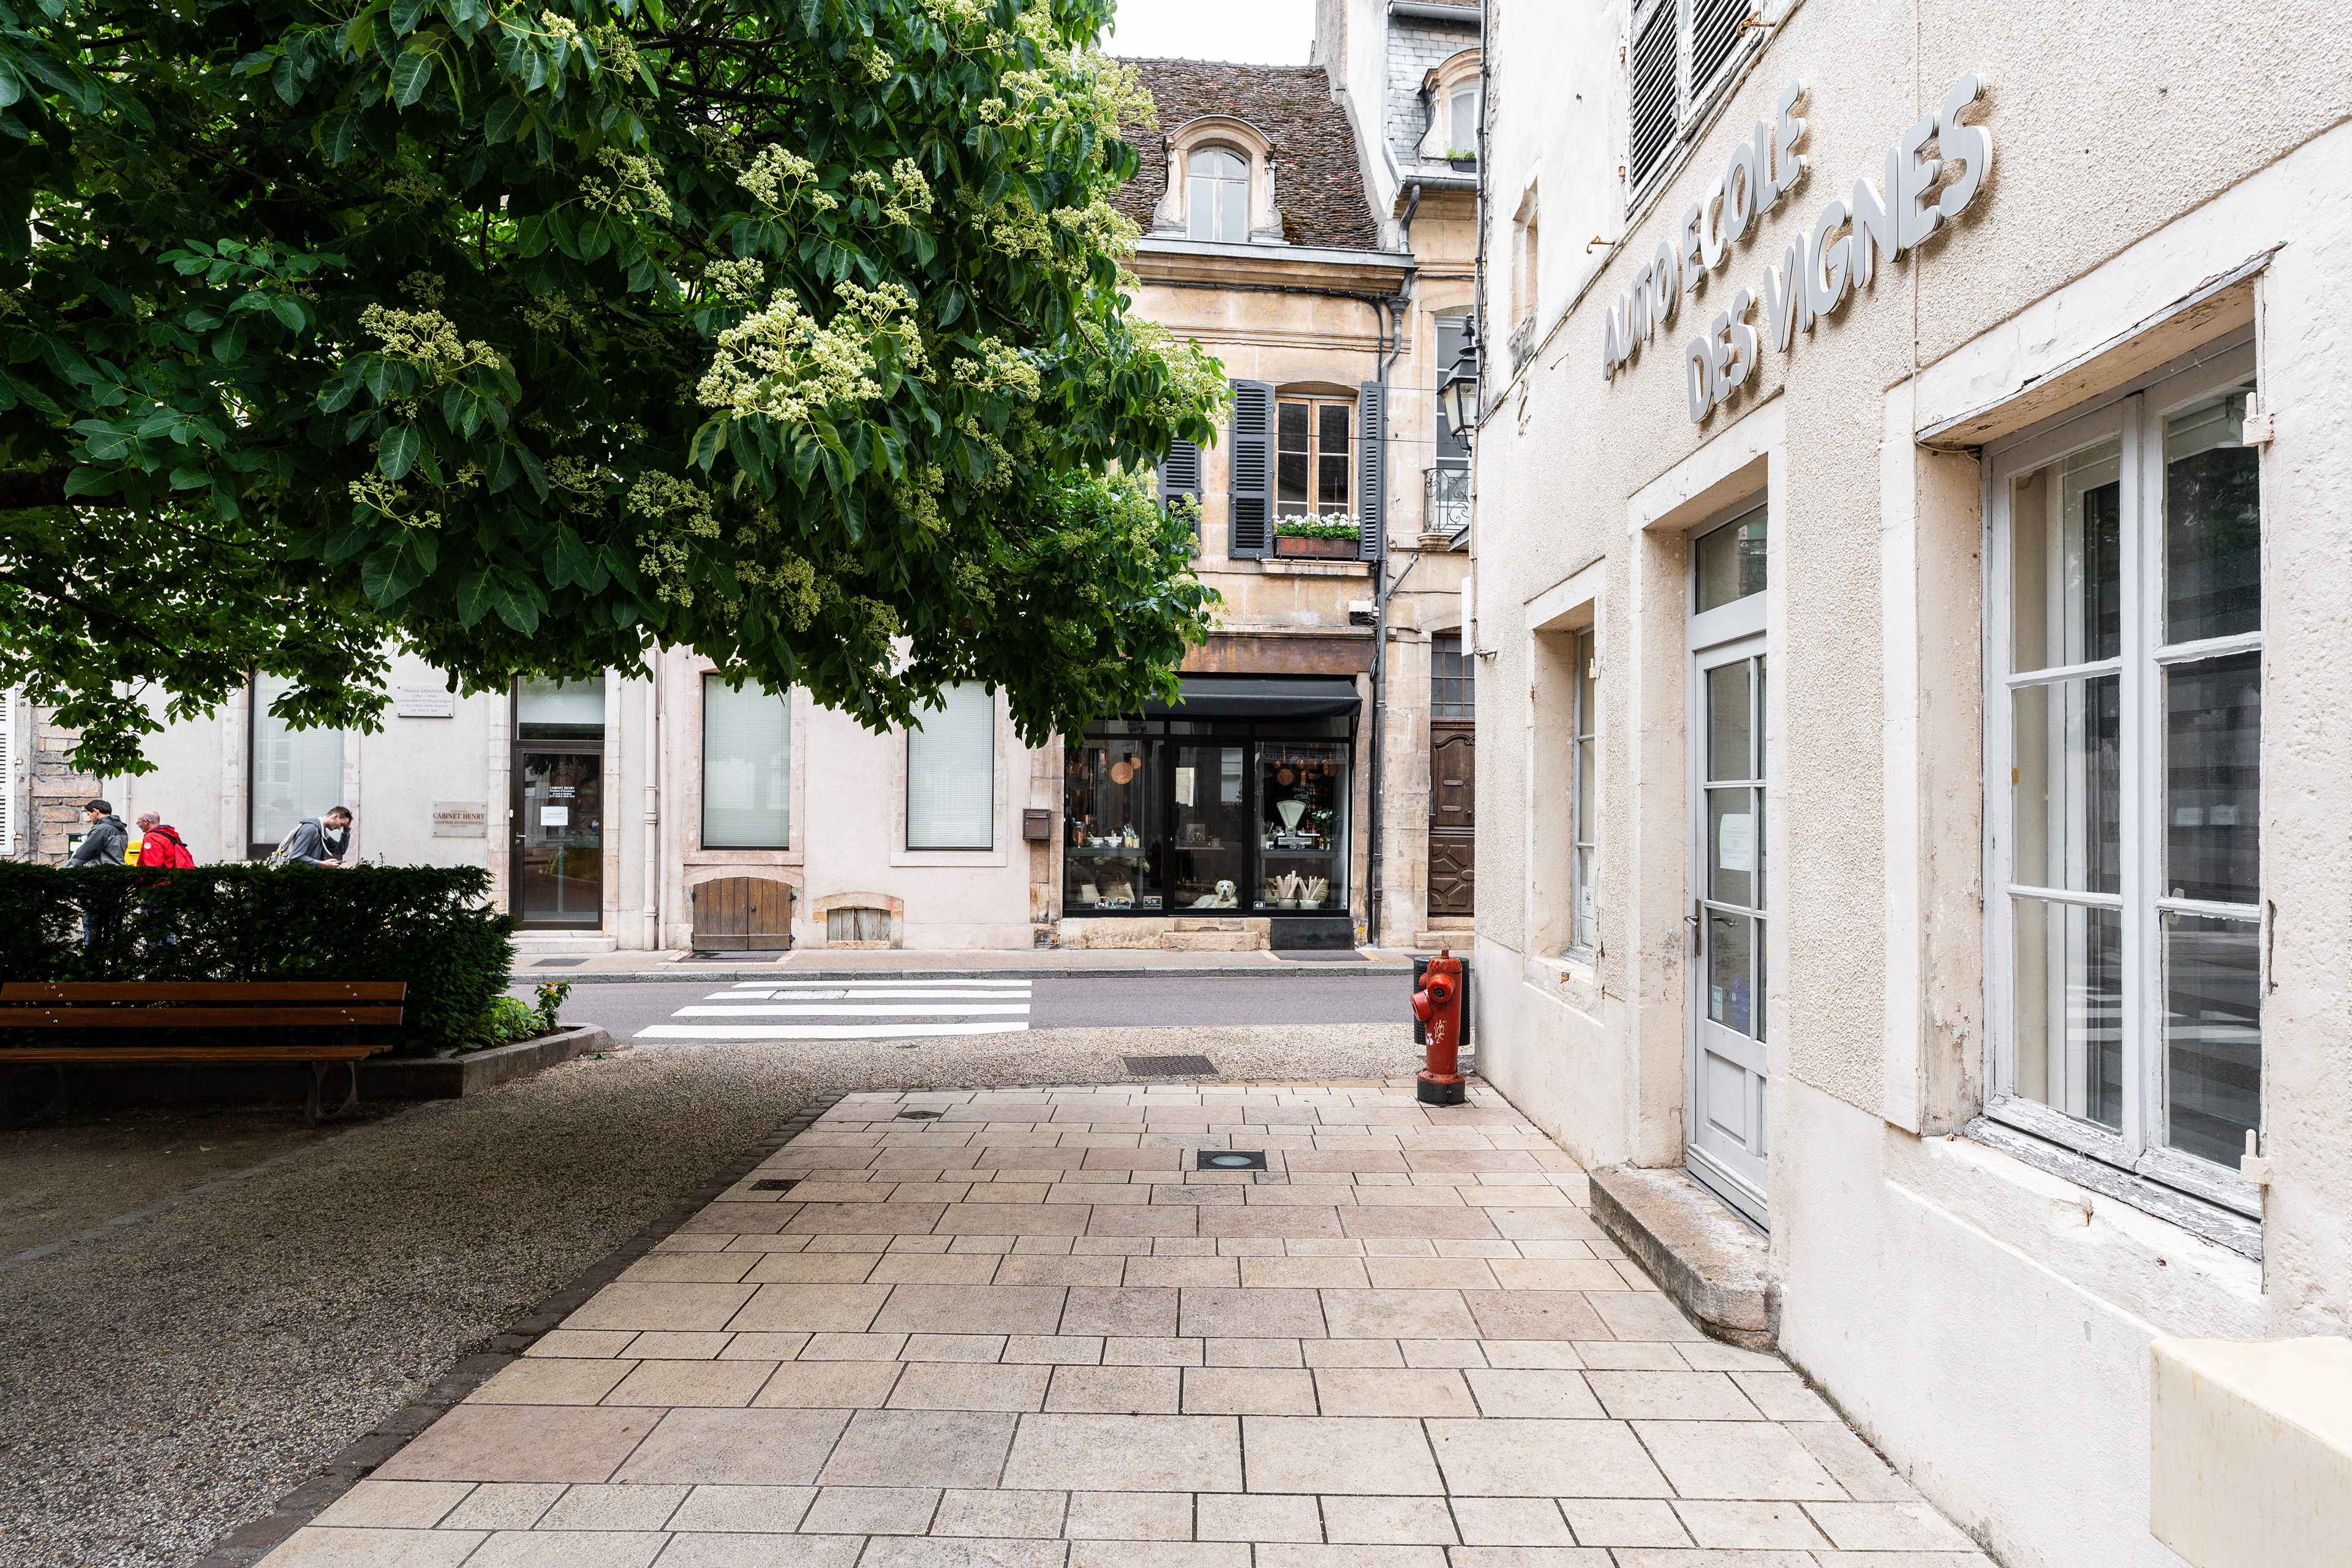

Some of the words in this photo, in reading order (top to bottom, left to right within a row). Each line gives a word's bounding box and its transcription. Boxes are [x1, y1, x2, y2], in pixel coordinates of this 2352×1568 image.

[1603, 240, 1679, 382] AUTO
[1683, 78, 1807, 294] ECOLE
[1686, 288, 1758, 424] DES
[1764, 73, 1993, 353] VIGNES
